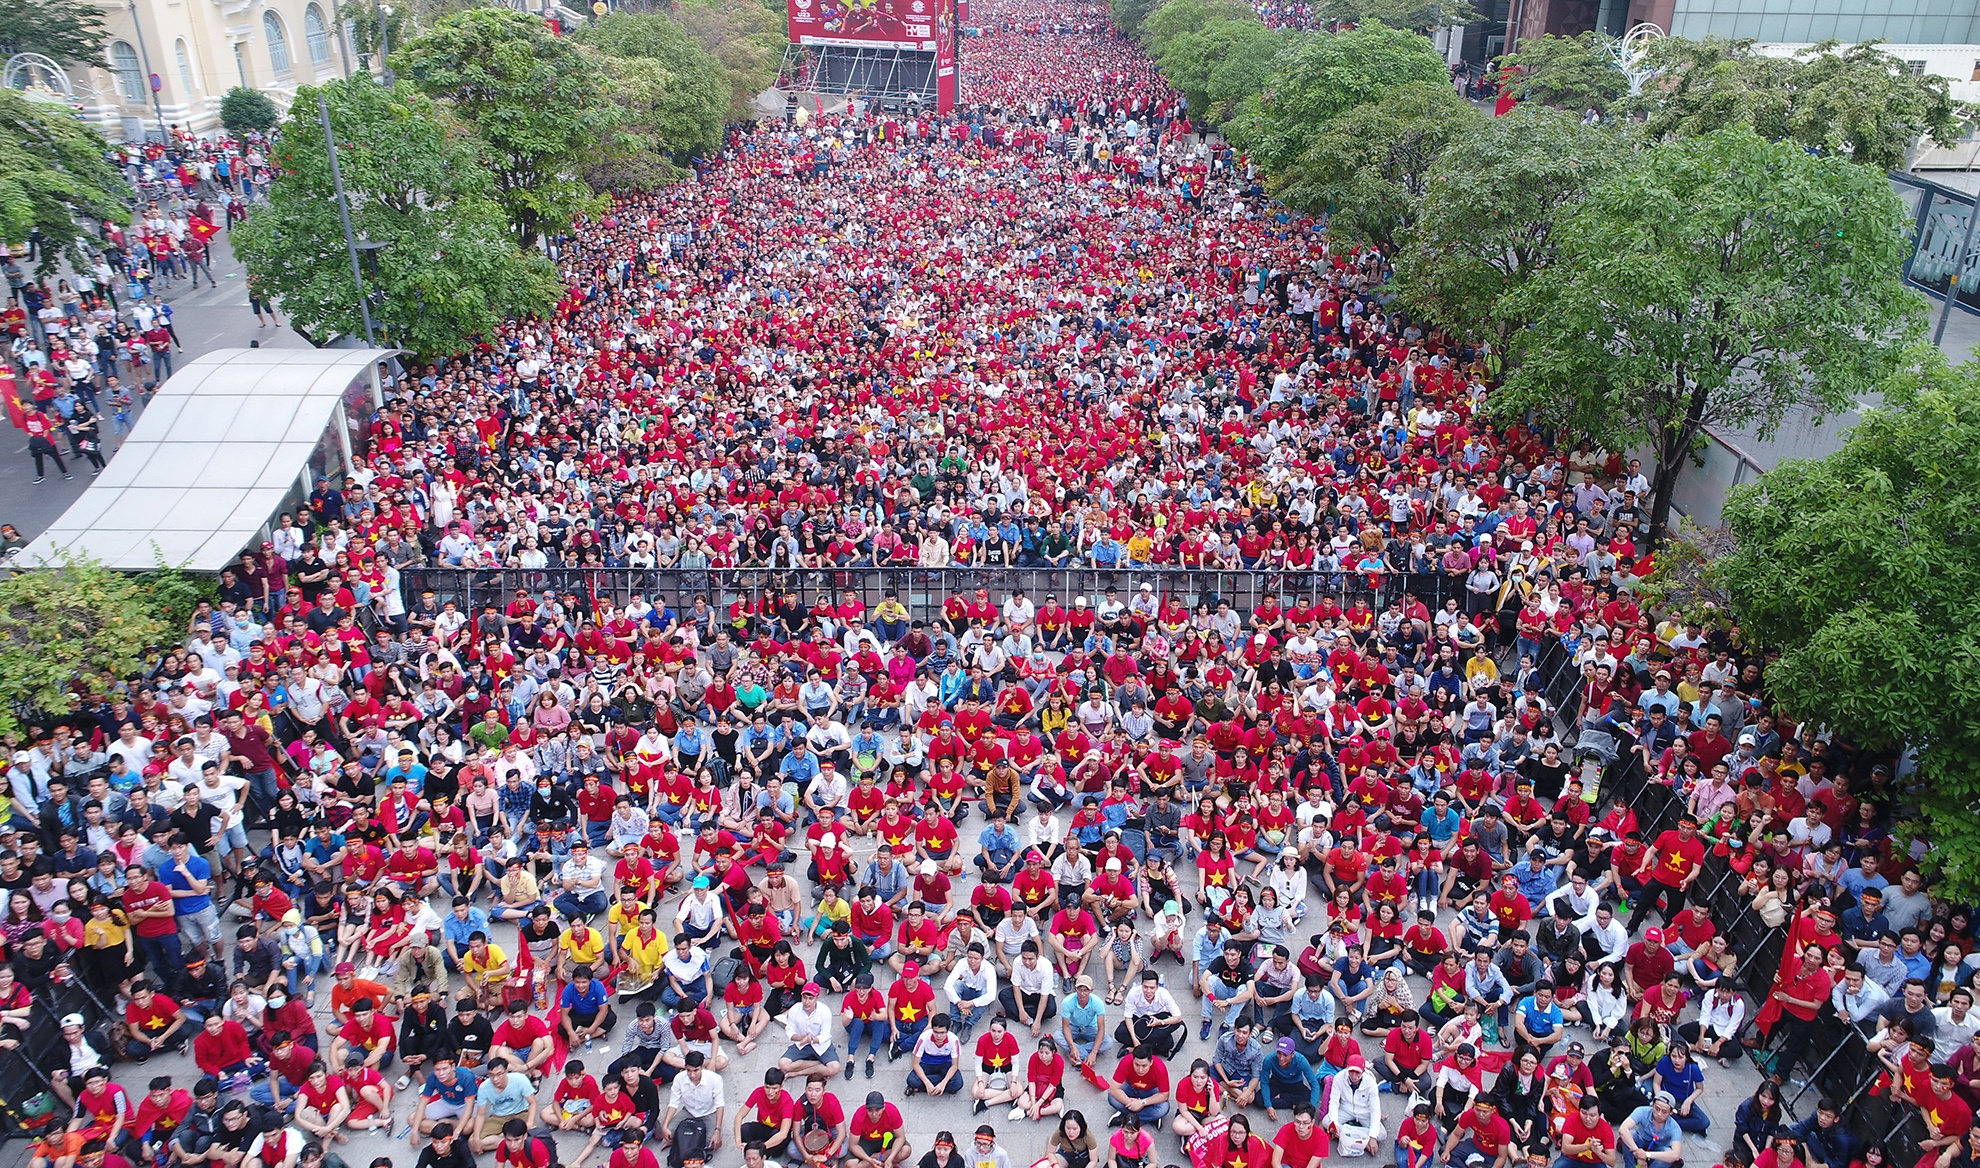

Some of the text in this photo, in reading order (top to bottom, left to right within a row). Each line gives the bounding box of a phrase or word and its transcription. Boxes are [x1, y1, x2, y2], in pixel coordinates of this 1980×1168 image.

[990, 554, 1000, 562] 24
[1134, 549, 1145, 558] 37
[1221, 969, 1242, 983] CR7
